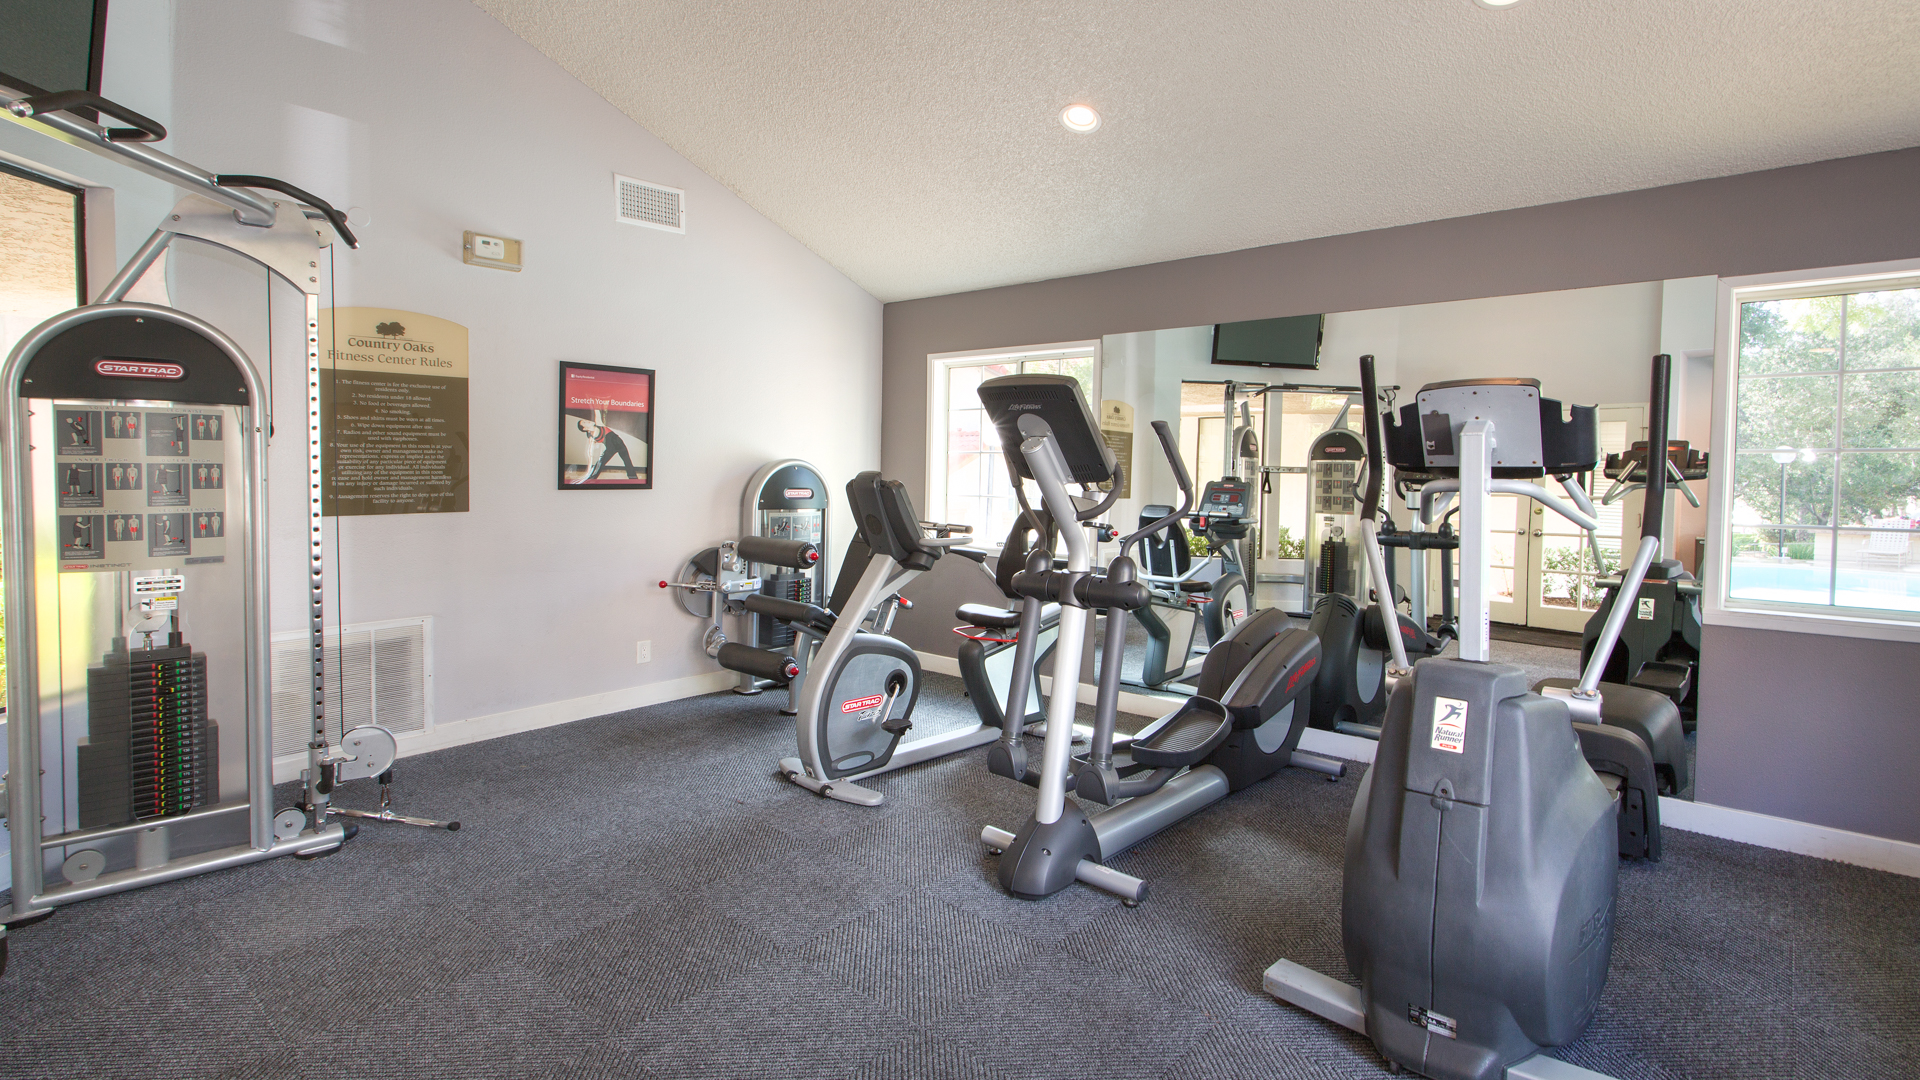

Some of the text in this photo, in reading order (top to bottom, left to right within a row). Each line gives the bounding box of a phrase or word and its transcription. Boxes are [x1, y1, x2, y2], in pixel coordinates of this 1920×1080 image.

[347, 337, 435, 353] Country Oaks
[327, 350, 453, 368] Fitness Center Rules
[571, 397, 594, 405] Stretch
[845, 698, 880, 709] STAR TRAC
[1435, 726, 1463, 738] Natural
[1434, 734, 1463, 743] Runner
